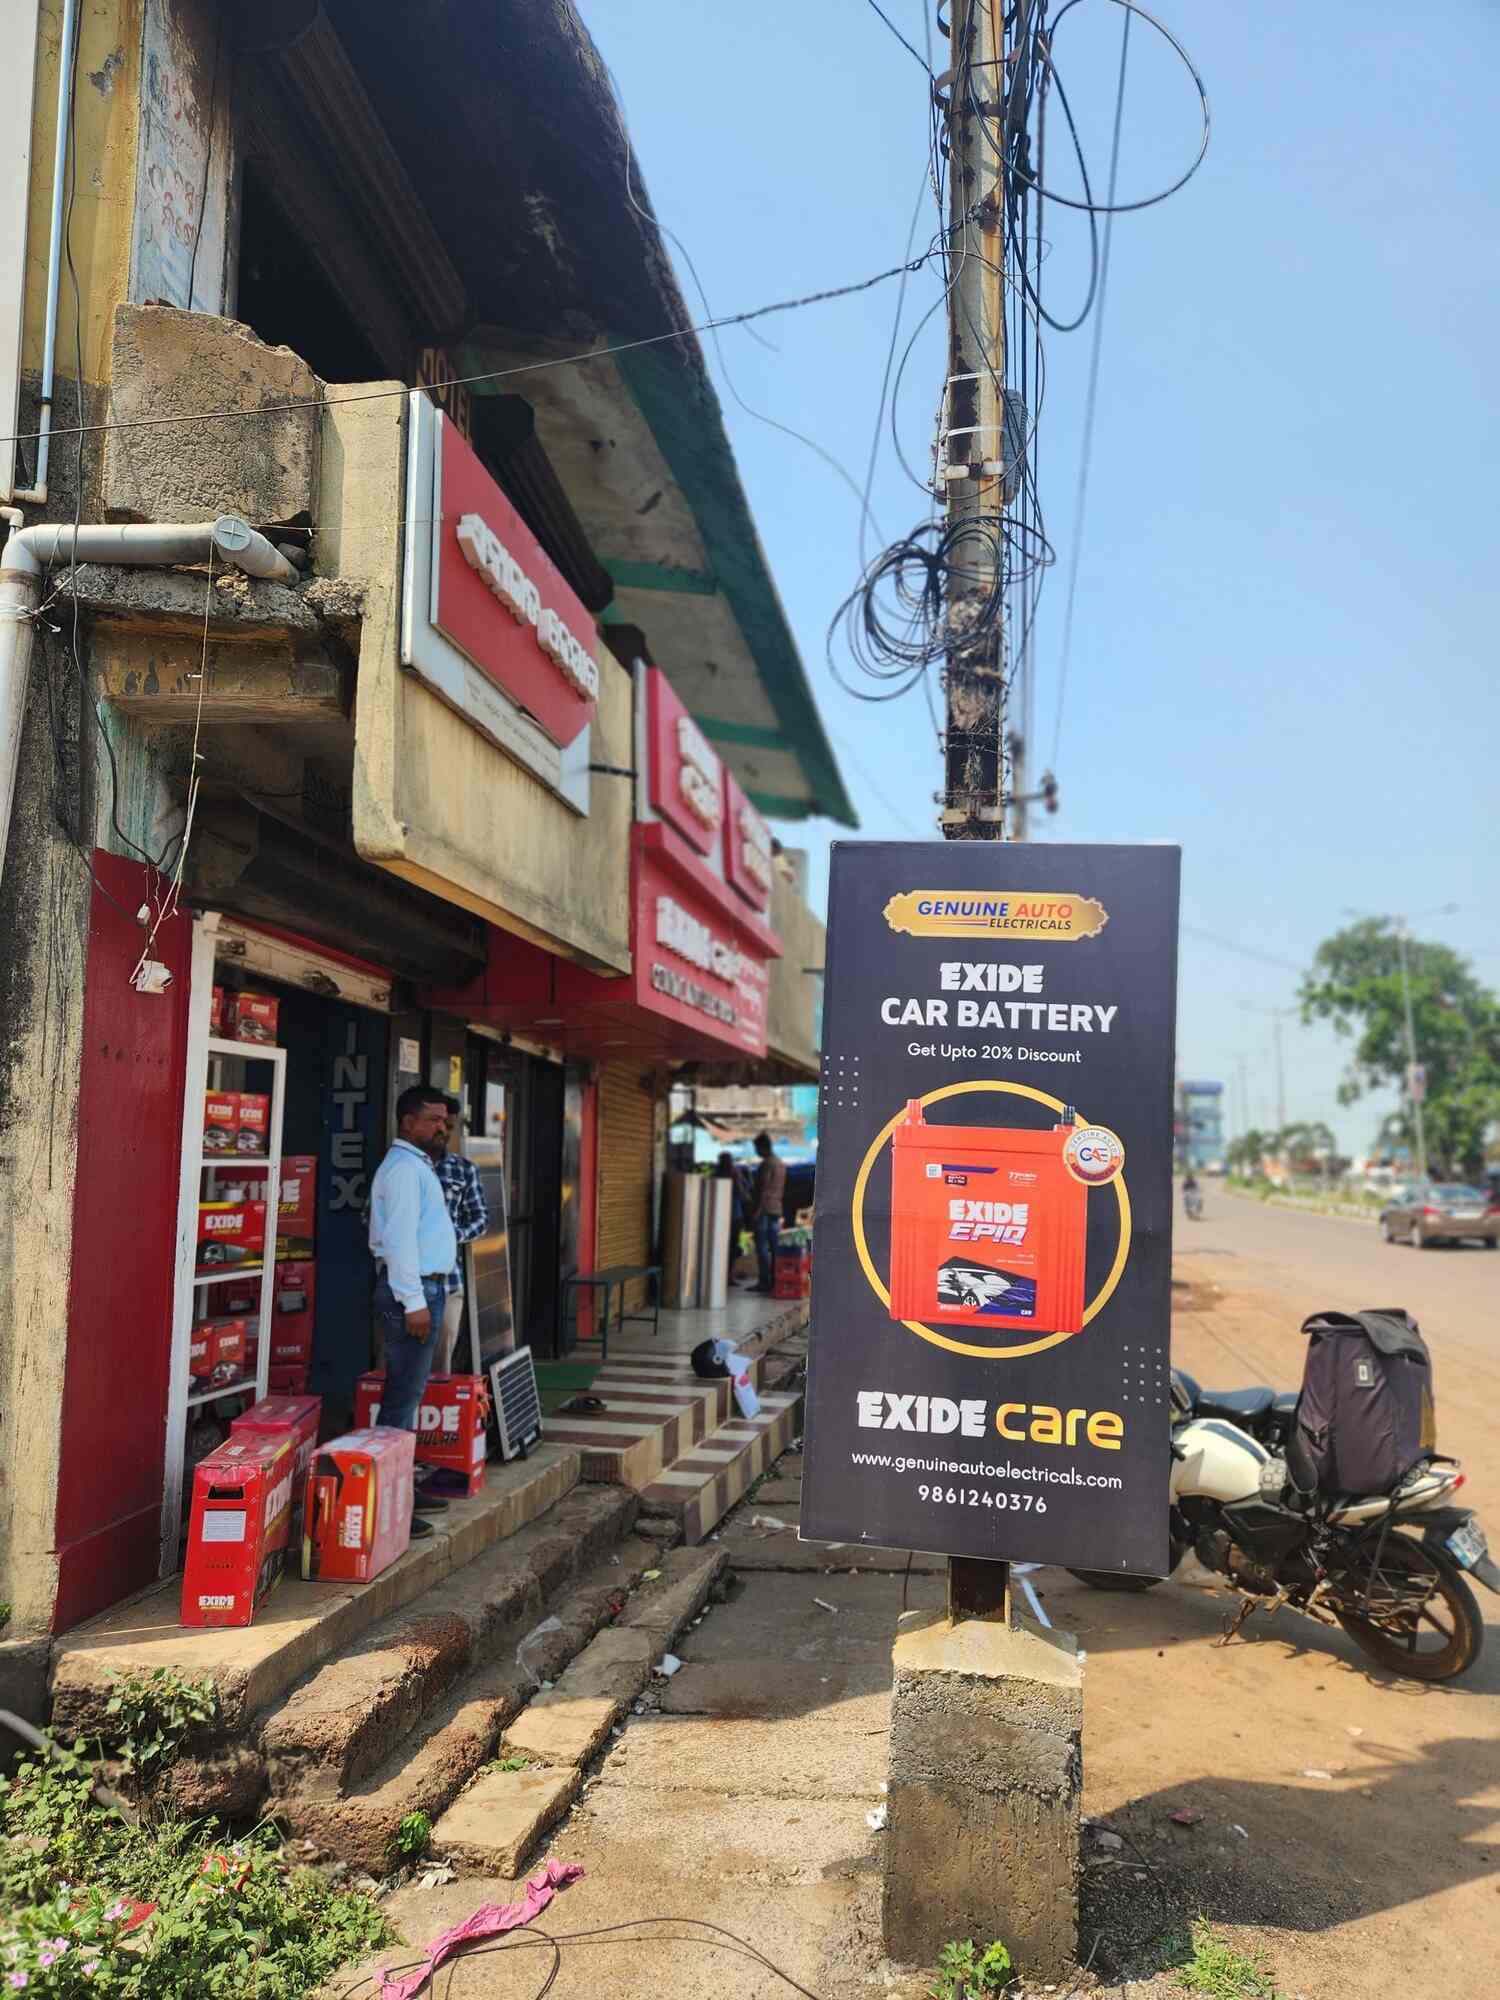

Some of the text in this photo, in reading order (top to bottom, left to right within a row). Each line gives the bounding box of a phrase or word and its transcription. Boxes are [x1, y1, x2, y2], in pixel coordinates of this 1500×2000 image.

[917, 900, 1073, 918] GENUINE AUTO
[989, 917, 1072, 931] ELECTRICALS
[940, 962, 1044, 993] EXIDE
[881, 998, 1118, 1033] CAR BATTERY
[907, 1043, 1082, 1063] Get Upto 20% Discount
[205, 1213, 244, 1230] EXIDE
[949, 1199, 1028, 1226] EXIDE
[948, 1222, 1027, 1246] EPIQ
[856, 1391, 1125, 1450] EXIDE care
[851, 1452, 1122, 1489] www.genuineautoelectricals.com
[918, 1485, 1047, 1513] 9861240376
[199, 1595, 235, 1607] EXIDE
